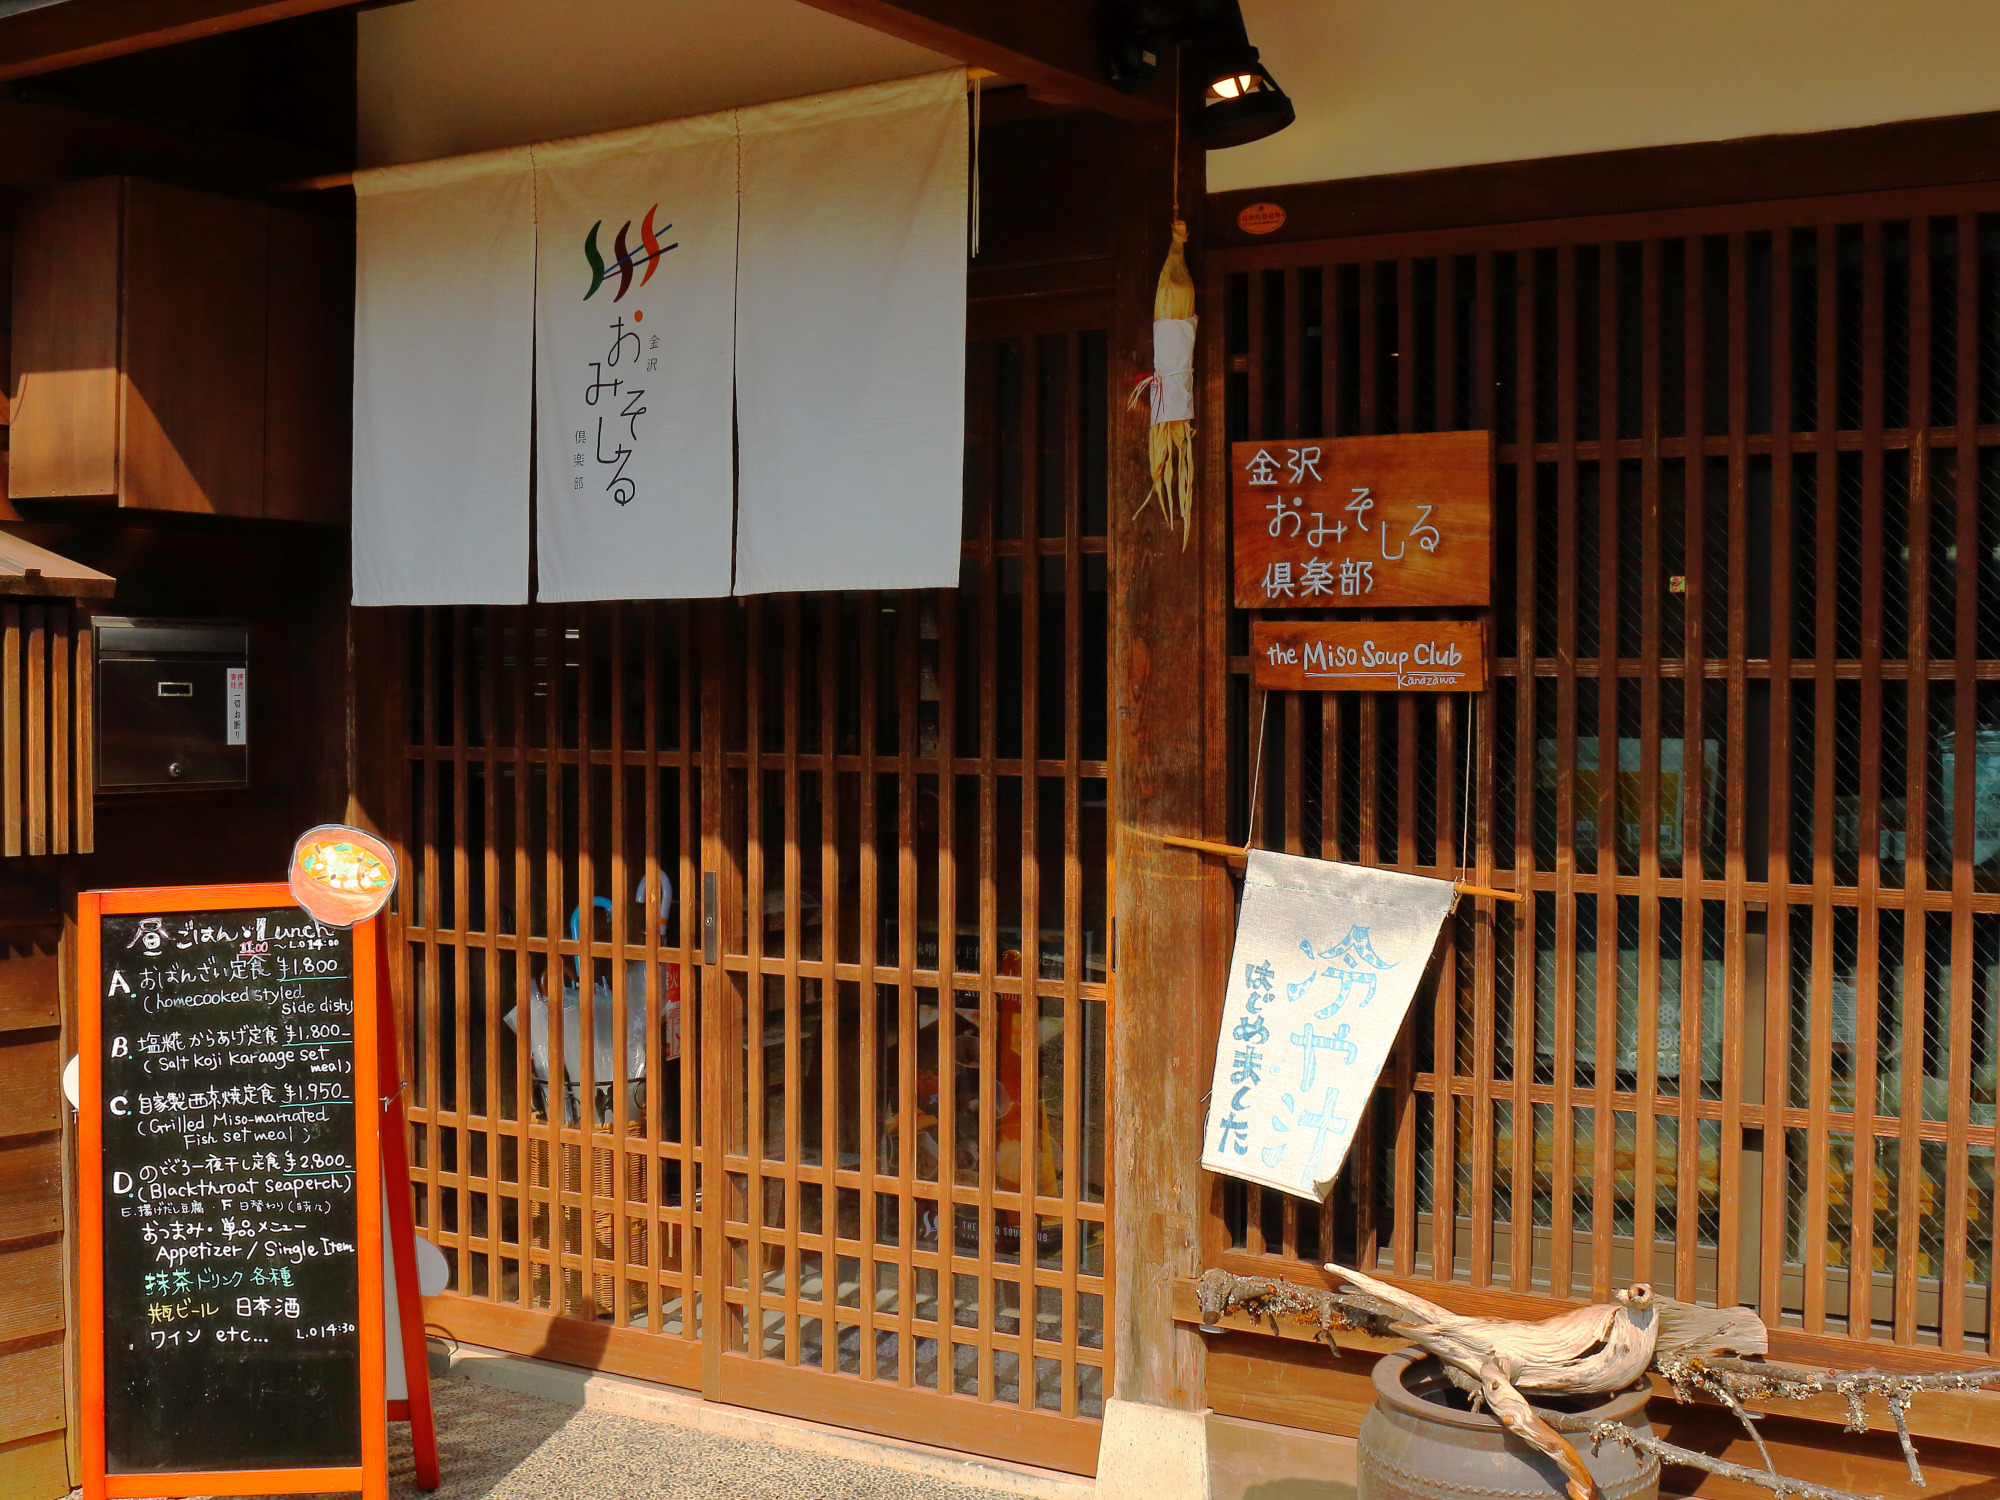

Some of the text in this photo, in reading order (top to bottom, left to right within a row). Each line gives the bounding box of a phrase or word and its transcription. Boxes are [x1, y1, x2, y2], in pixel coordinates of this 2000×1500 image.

[646, 335, 660, 371] 金沢
[585, 310, 647, 507] おみそしる
[574, 430, 587, 490] 倶楽部
[1245, 446, 1322, 484] 金沢
[1265, 488, 1440, 560] おみそしる
[1261, 557, 1373, 598] 倶楽部
[1267, 640, 1463, 674] the Miso Soup Club
[1397, 674, 1458, 689] Kanazawa
[126, 917, 335, 956] 昼ごはん Lunch
[239, 940, 269, 954] 11:00
[108, 969, 137, 998] A.
[139, 955, 272, 990] おばんざい定食
[254, 983, 306, 1005] styled
[281, 1000, 316, 1015] side
[111, 1036, 133, 1060] B.
[300, 1045, 330, 1061] set
[1218, 960, 1275, 1156] はじめました
[1262, 925, 1402, 1187] 冷や汁
[109, 1095, 132, 1116] C.
[183, 1132, 218, 1151] Fish
[223, 1126, 252, 1143] set
[113, 1171, 134, 1198] D.
[155, 1241, 243, 1269] Appetizer
[264, 1239, 319, 1264] Single
[319, 1236, 356, 1256] Item
[249, 1265, 295, 1288] 各種
[236, 1296, 301, 1319] 日本酒
[150, 1328, 201, 1350] ワイン
